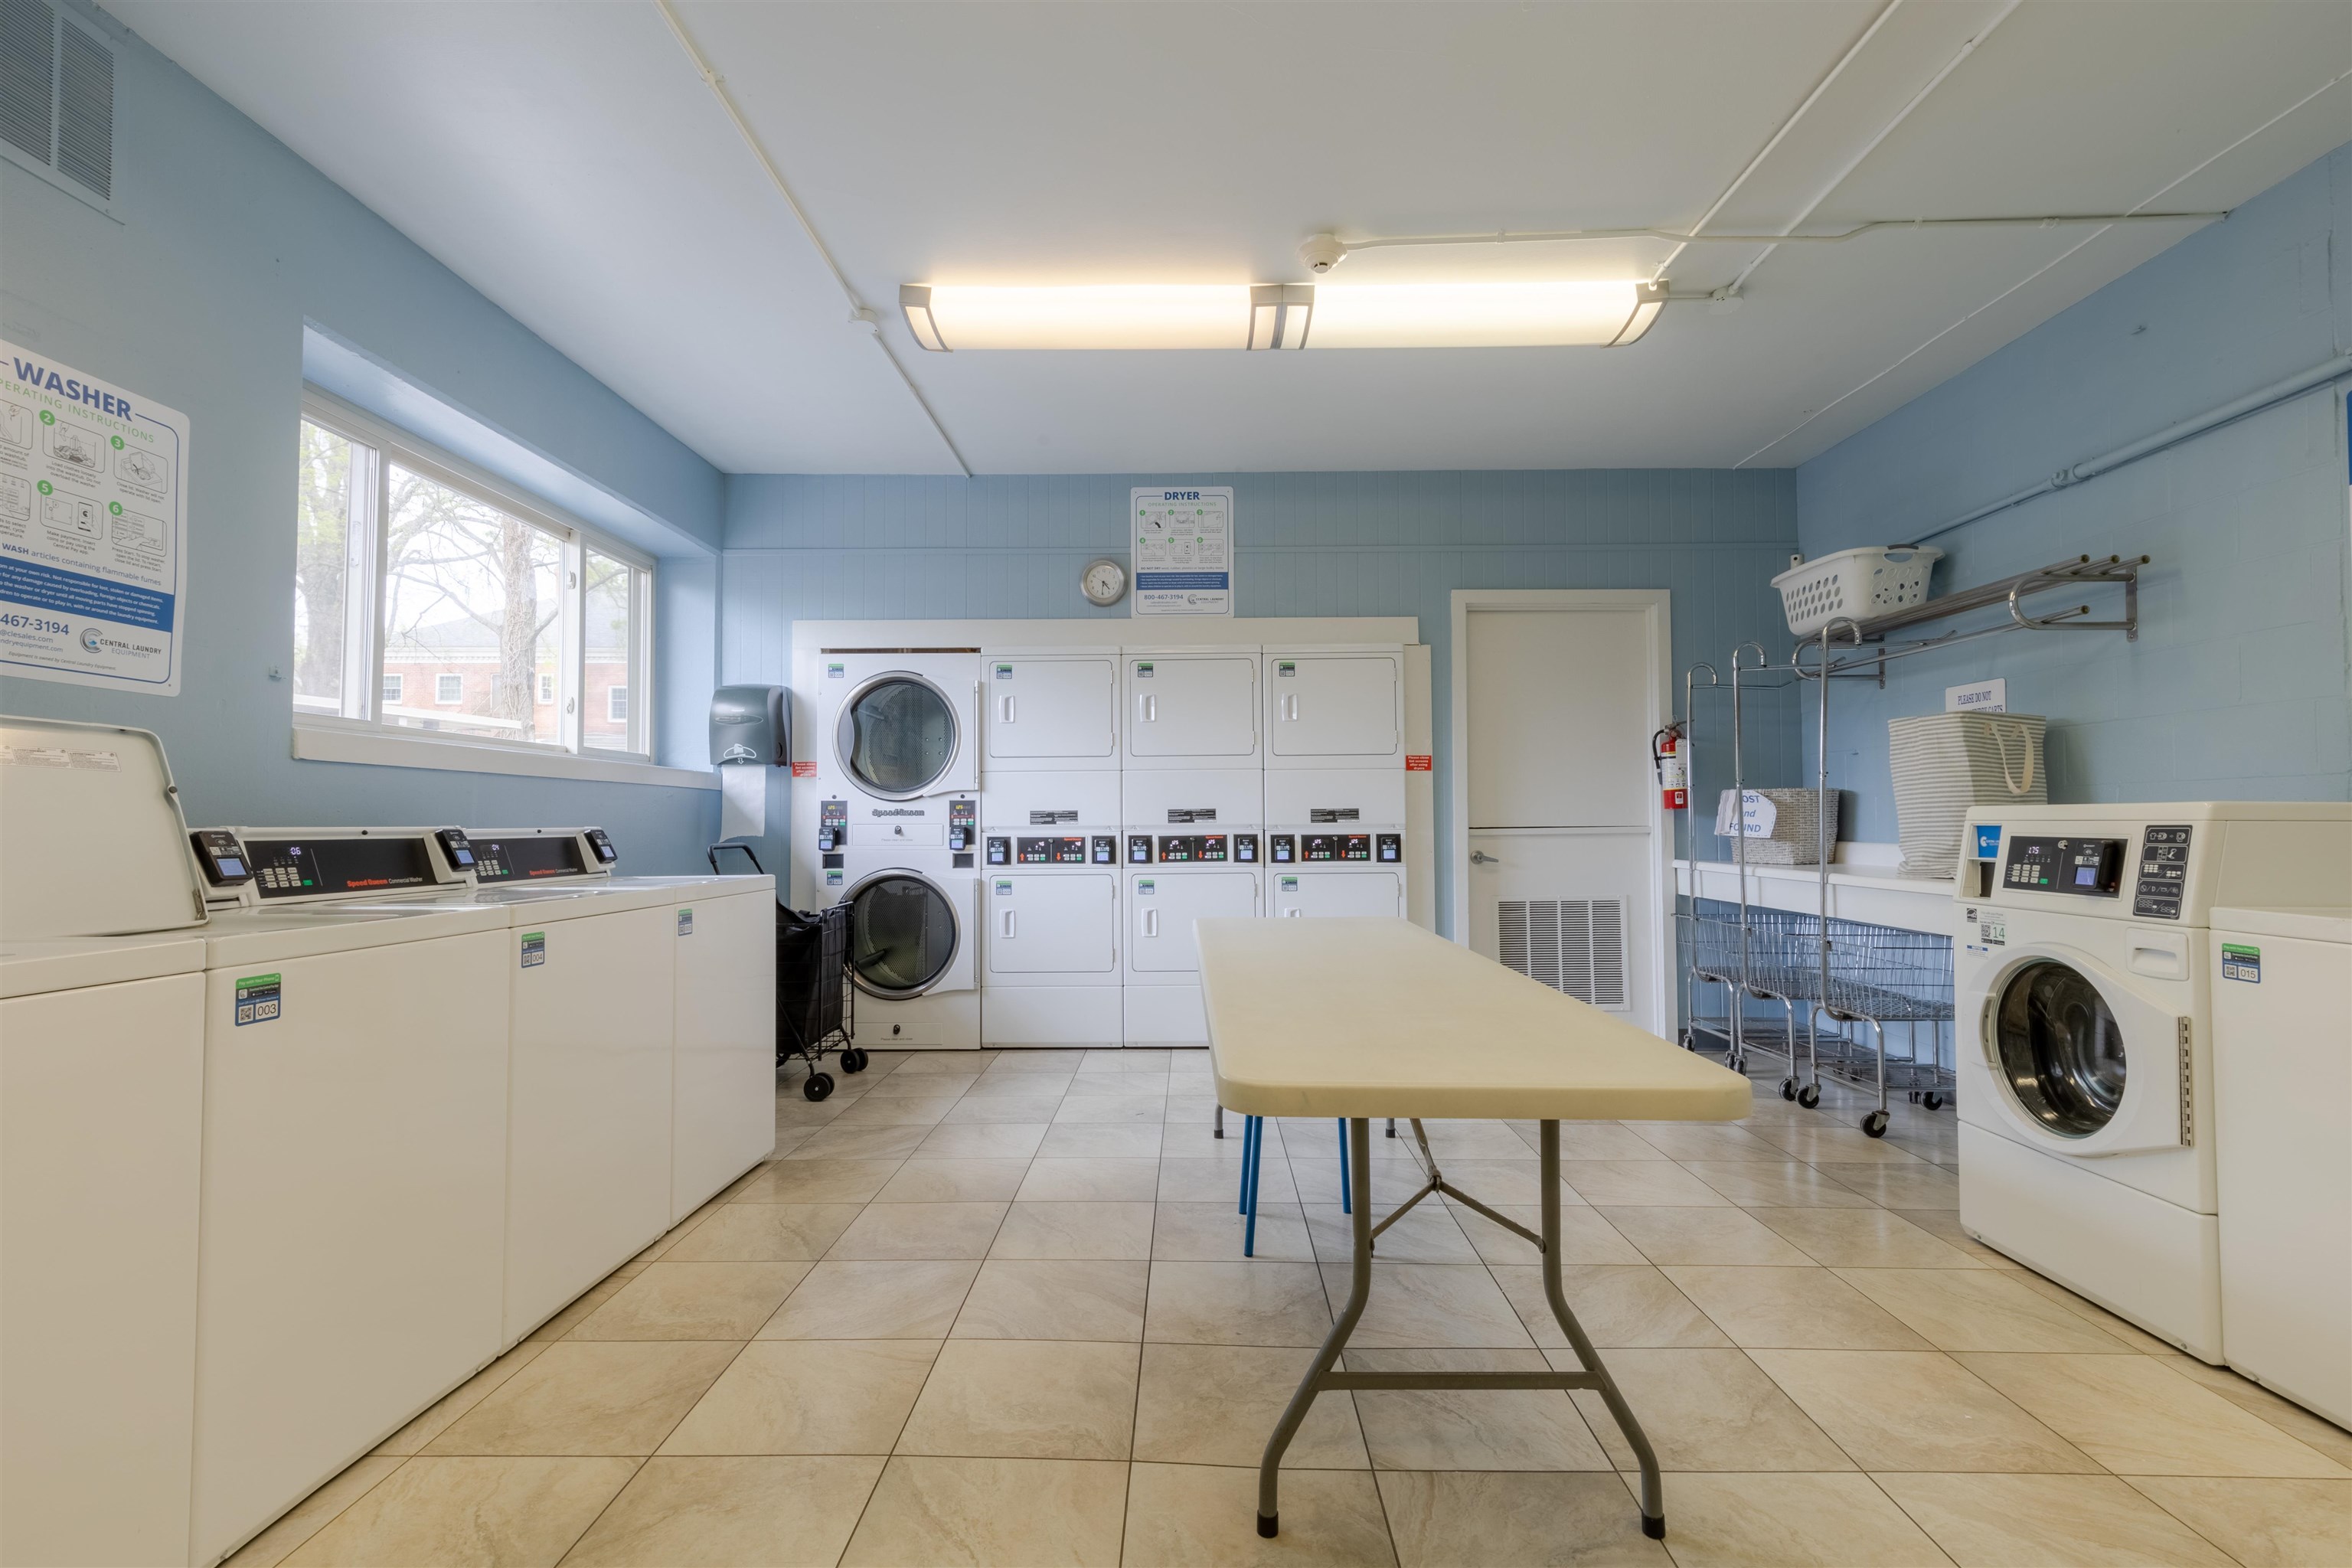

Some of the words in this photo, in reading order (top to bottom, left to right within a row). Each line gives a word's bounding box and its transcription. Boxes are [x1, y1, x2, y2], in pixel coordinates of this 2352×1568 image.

[14, 357, 132, 422] WASHER
[68, 403, 154, 443] INSTRUCTIONS
[1165, 492, 1200, 500] DRYER
[2, 543, 28, 555] WASH
[31, 551, 59, 562] articles
[62, 558, 100, 573] containing
[102, 566, 139, 581] flammable
[141, 575, 160, 586] fumes
[22, 576, 43, 585] damage
[63, 578, 90, 587] responsible
[130, 591, 150, 599] damaged
[118, 612, 134, 620] laundry
[100, 639, 130, 649] CENTRAL
[132, 644, 161, 655] LAUNDRY
[112, 648, 150, 659] EQUIPMENT
[1958, 694, 1974, 705] PLEASE
[1975, 692, 1981, 702] DO
[1982, 691, 1991, 701] NOT
[872, 809, 898, 817] Speed
[1993, 927, 2005, 939] 14
[533, 952, 542, 962] 004
[2241, 969, 2256, 978] 015
[258, 1004, 276, 1016] 003
